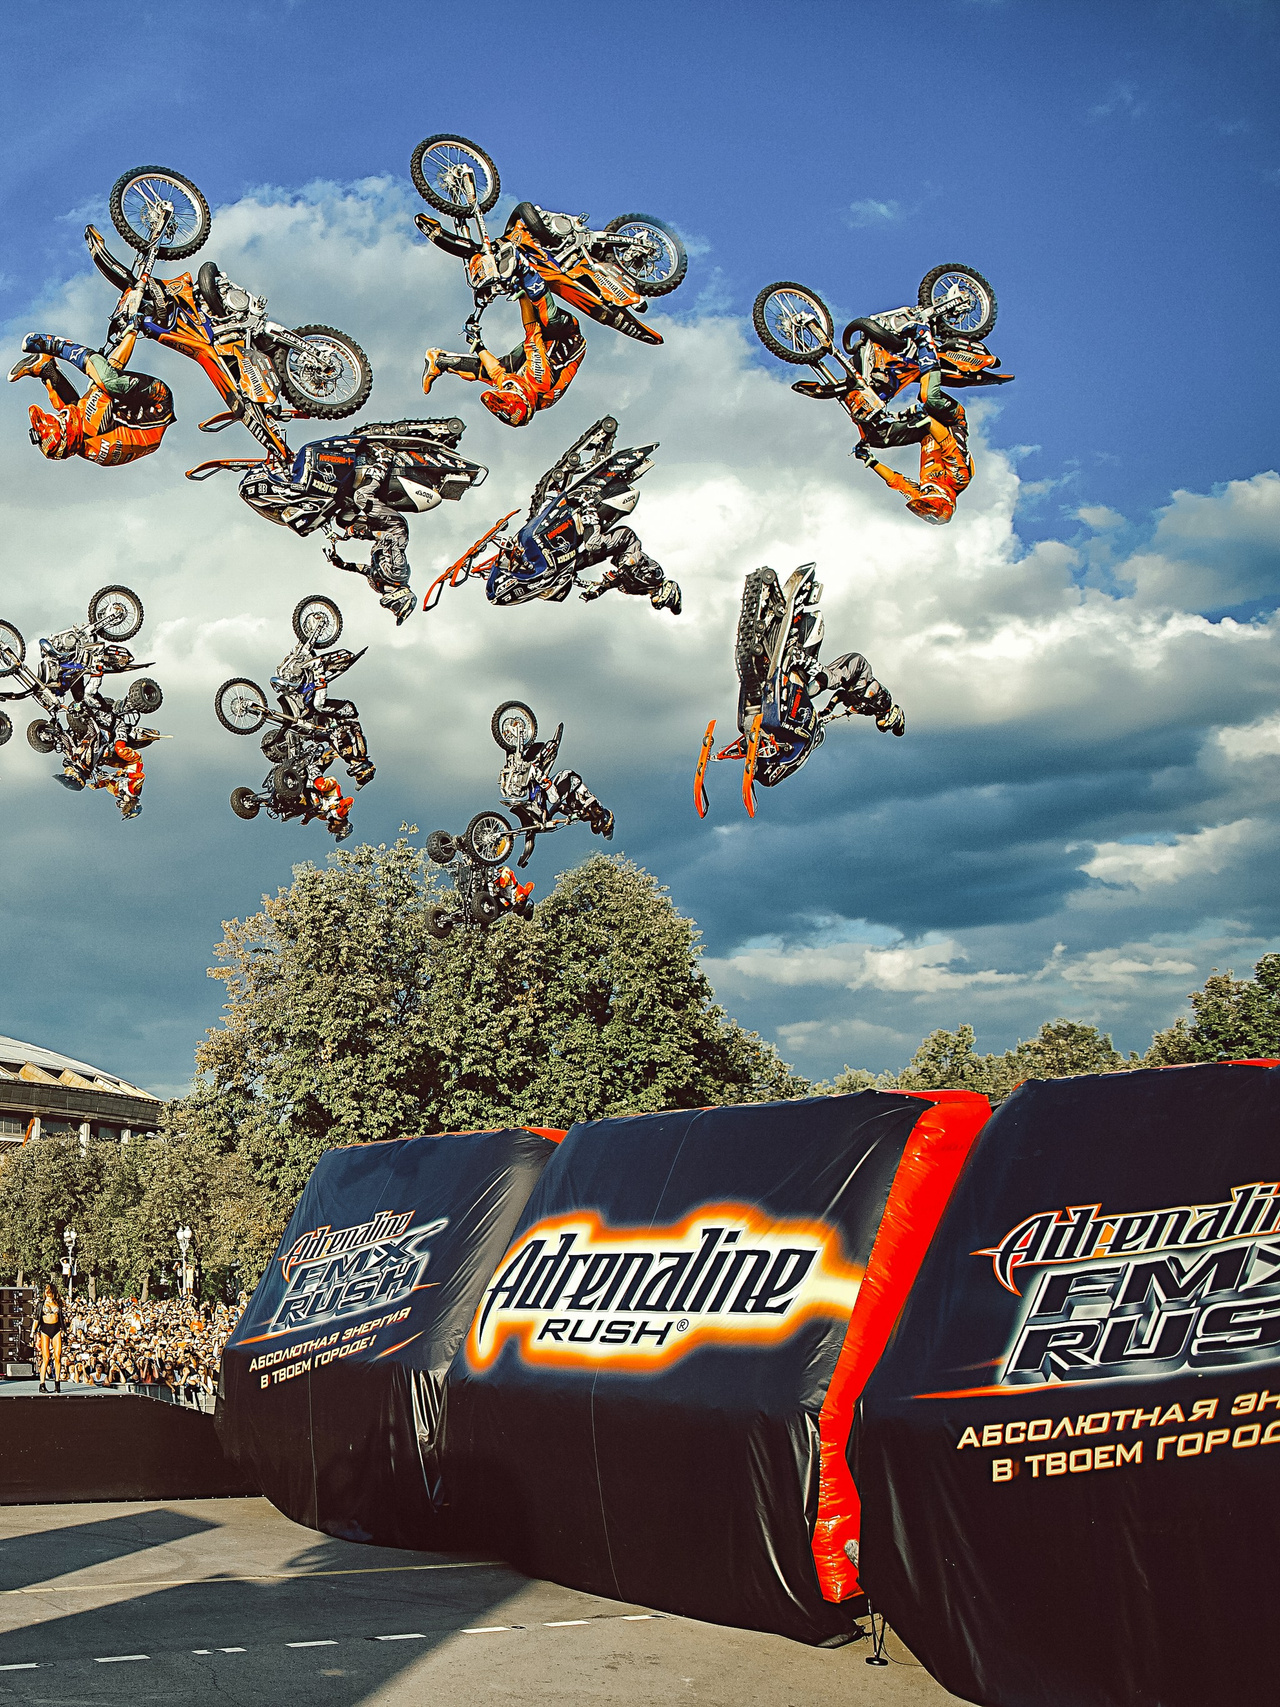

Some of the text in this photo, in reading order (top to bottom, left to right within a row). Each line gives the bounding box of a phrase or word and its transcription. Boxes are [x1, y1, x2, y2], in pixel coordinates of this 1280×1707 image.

[278, 1210, 416, 1282] Adrenaline
[291, 1218, 449, 1294] FMX
[273, 1254, 426, 1327] RUSH
[478, 1227, 822, 1349] Adrenaline
[249, 1306, 412, 1373] АБСОЛЮТНАЯ ЭНЕРГИЯ
[260, 1334, 378, 1390] В ТВОЕМ ГОРОДЕ!
[536, 1318, 674, 1347] RUSH
[956, 1397, 1219, 1450] АБСОЛЮТНАЯ
[992, 1457, 1013, 1482] В
[1024, 1441, 1143, 1478] ТВОЕМ
